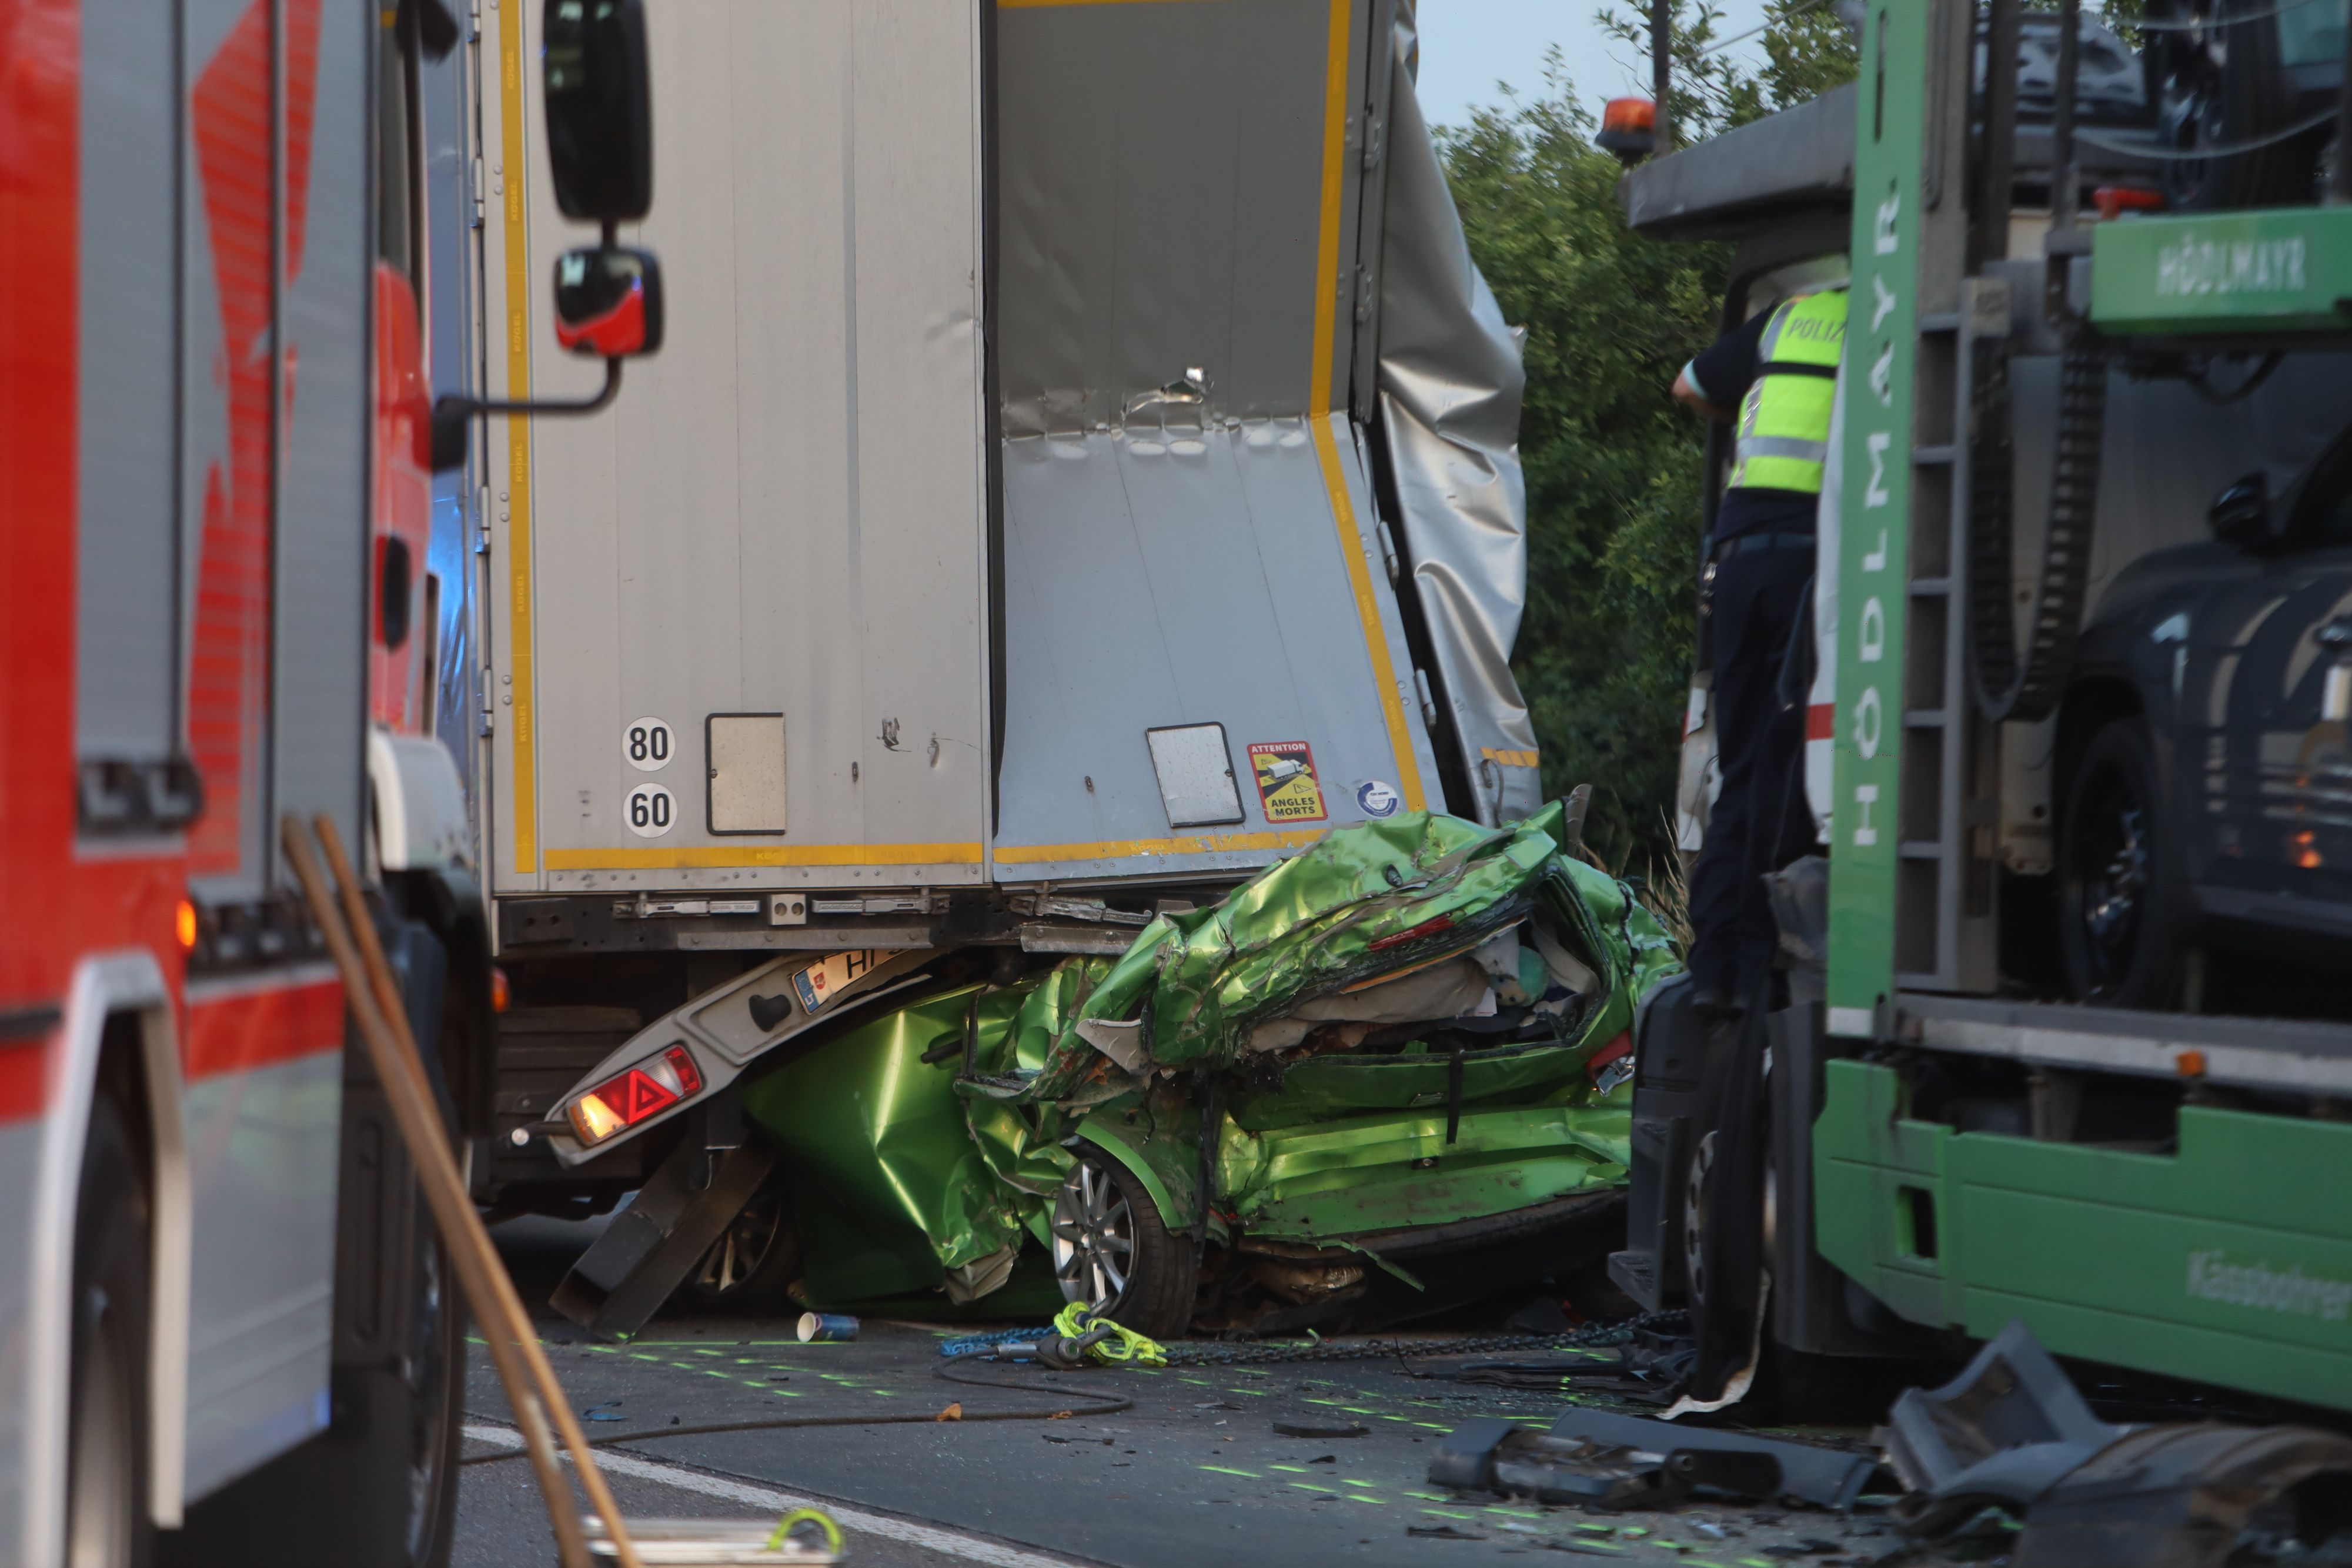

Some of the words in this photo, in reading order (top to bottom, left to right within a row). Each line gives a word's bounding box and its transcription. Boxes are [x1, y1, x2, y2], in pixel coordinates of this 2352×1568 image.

[2156, 232, 2306, 296] HÖDLMAYR
[1852, 192, 1900, 845] HÖDLMAYR
[630, 727, 668, 761] 80
[1252, 743, 1307, 753] ATTENTION
[631, 793, 670, 827] 60
[1272, 797, 1315, 807] ANGLES
[1275, 806, 1316, 817] MORTS
[805, 993, 814, 1006] LT
